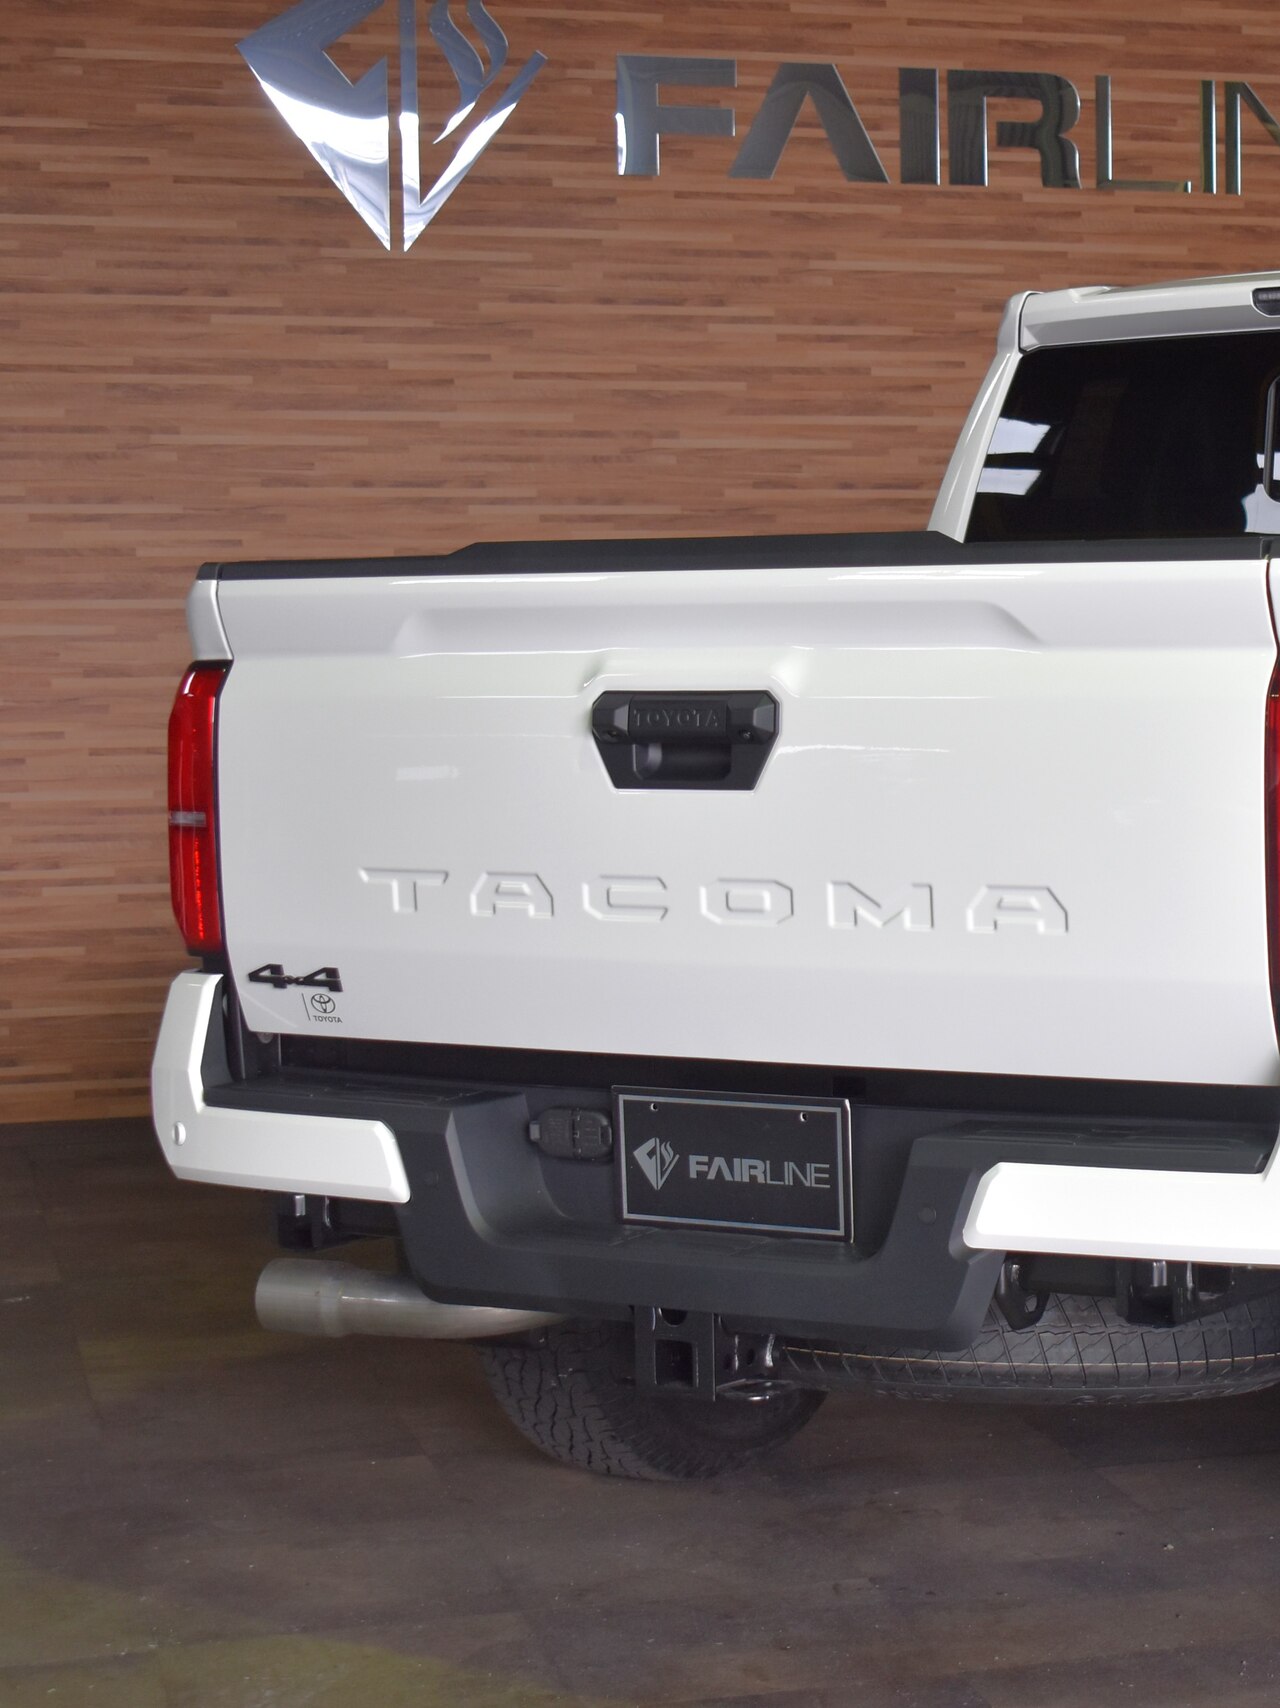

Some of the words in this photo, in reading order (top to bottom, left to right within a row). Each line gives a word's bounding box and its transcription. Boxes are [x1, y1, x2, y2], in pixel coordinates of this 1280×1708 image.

[633, 708, 719, 727] TOYOTA
[358, 866, 1070, 934] TACOMA
[312, 1014, 343, 1024] TOYOTA
[689, 1154, 831, 1189] FAIRLINE
